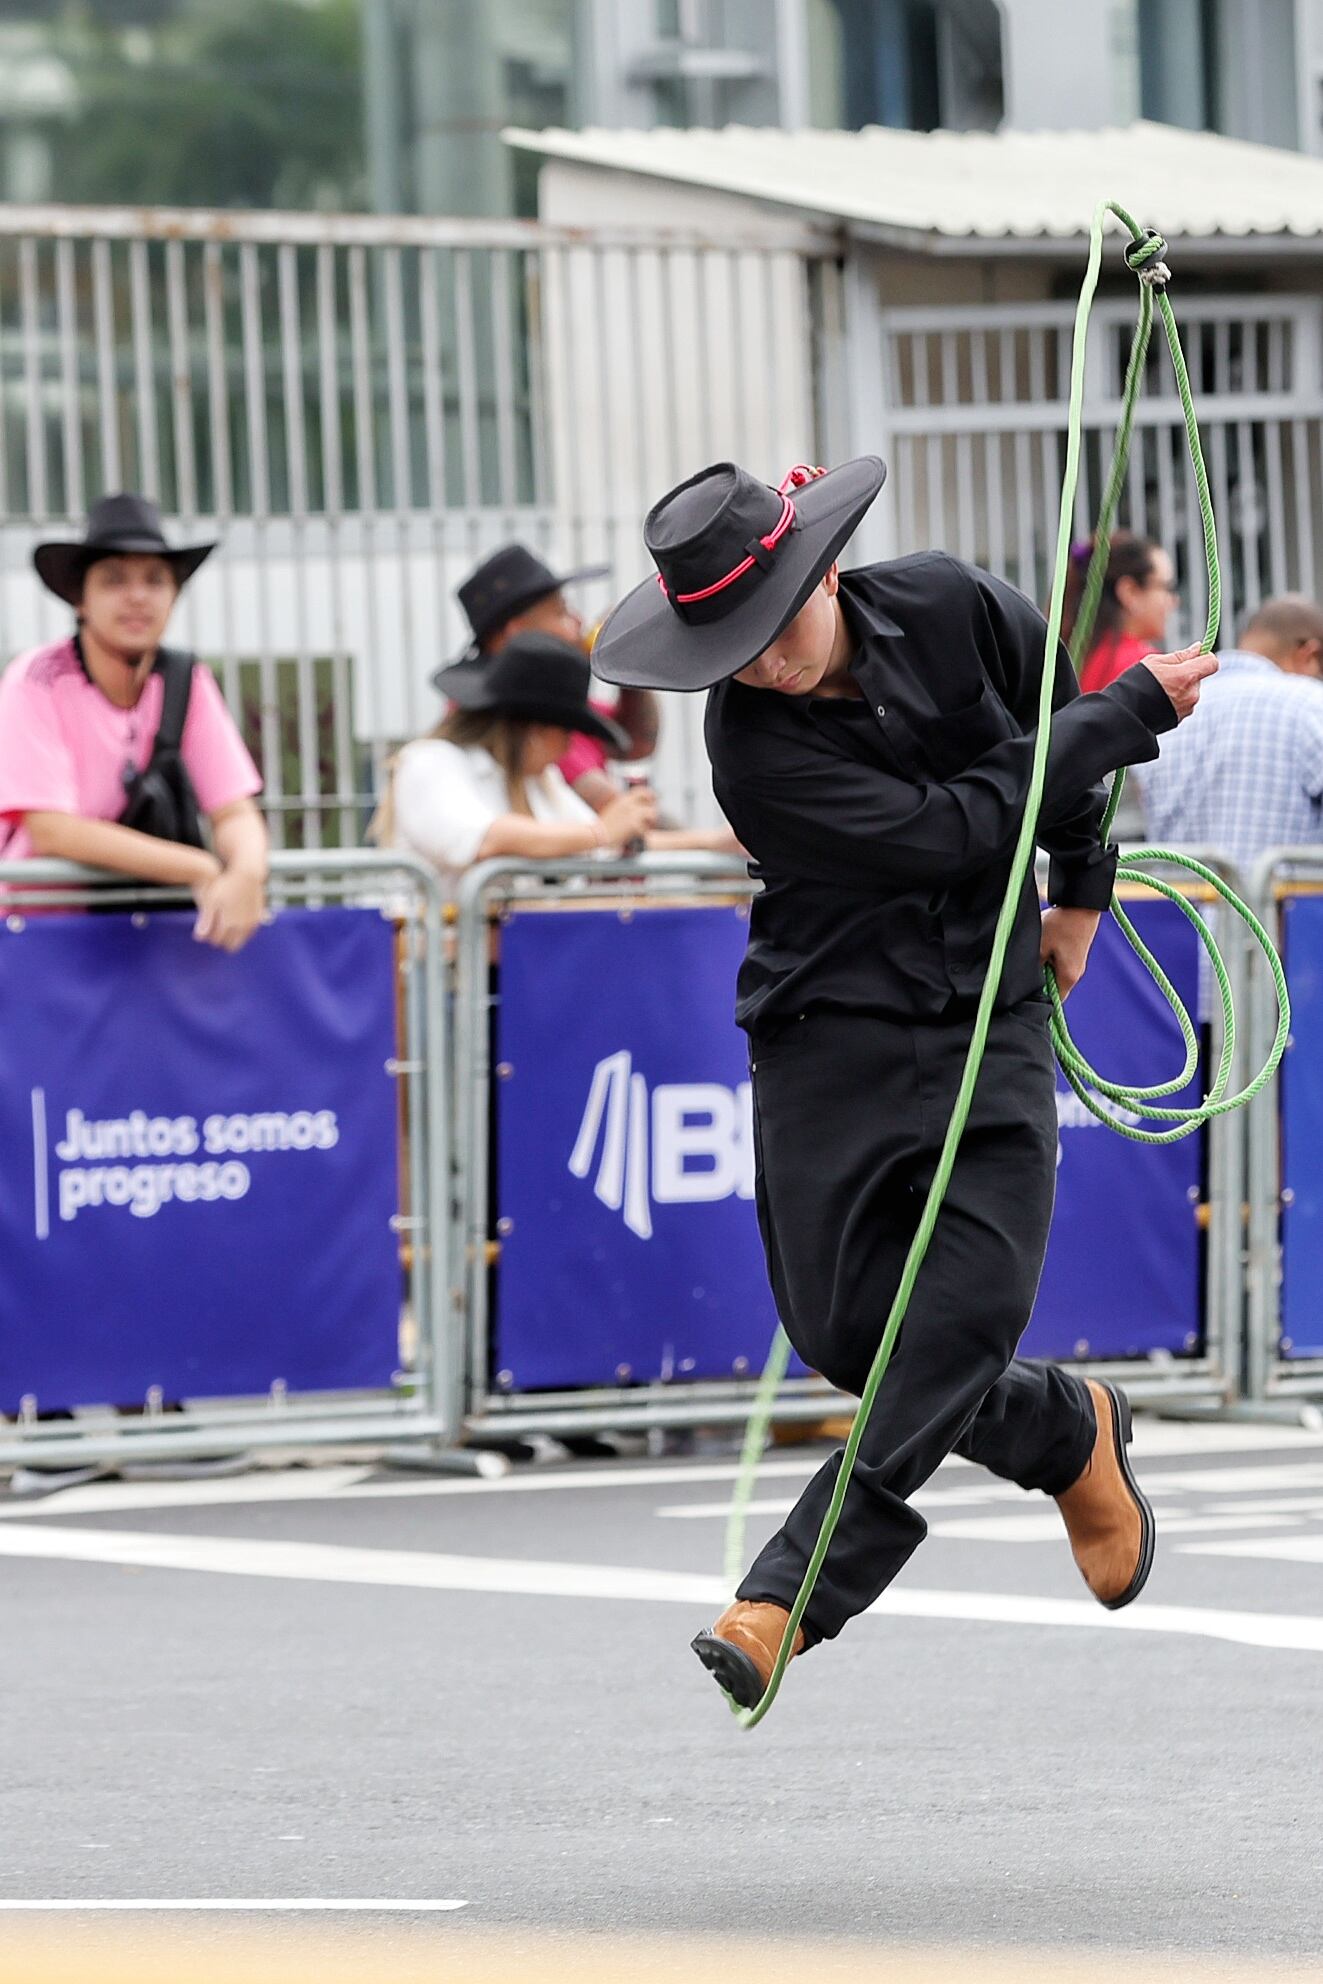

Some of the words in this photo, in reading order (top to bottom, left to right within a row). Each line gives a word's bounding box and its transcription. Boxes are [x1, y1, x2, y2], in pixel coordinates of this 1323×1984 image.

[55, 1107, 199, 1161] Juntos
[203, 1110, 339, 1154] somos
[59, 1160, 250, 1221] progreso
